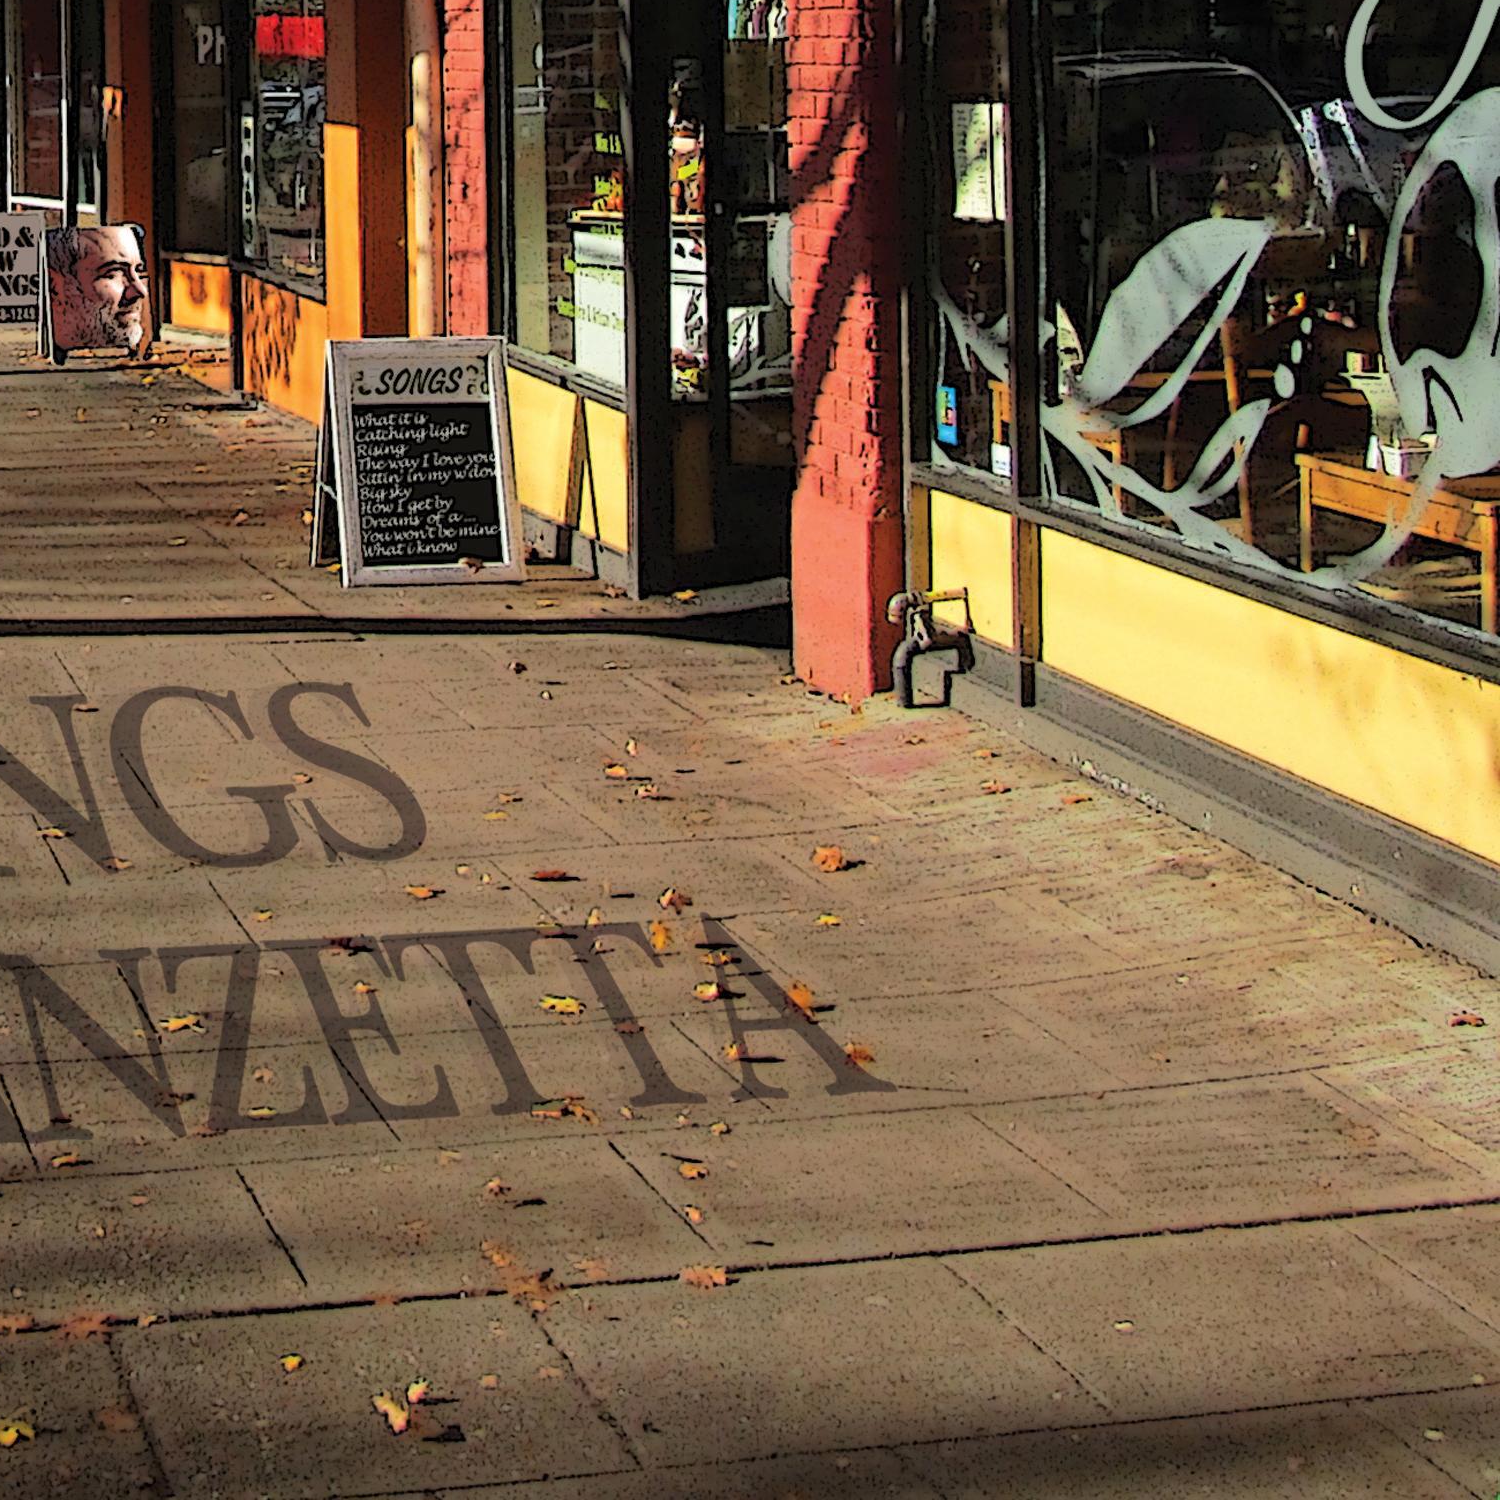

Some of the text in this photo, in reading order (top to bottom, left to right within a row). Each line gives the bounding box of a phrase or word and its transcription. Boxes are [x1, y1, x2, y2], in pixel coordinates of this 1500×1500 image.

[15, 226, 36, 248] &
[374, 367, 463, 396] SONGS
[354, 411, 429, 428] What it is
[354, 422, 469, 443] Catching light
[357, 443, 409, 459] Rising
[358, 456, 388, 470] The
[389, 457, 420, 471] way
[423, 453, 430, 468] I
[432, 452, 465, 467] love
[428, 469, 452, 485] my
[360, 484, 413, 502] Big sky
[360, 495, 453, 517] How I get by
[361, 514, 422, 529] Dreams
[426, 511, 445, 527] of
[361, 529, 393, 543] You
[438, 523, 457, 538] be
[459, 523, 500, 537] mine
[362, 542, 406, 558] What
[416, 540, 458, 554] know
